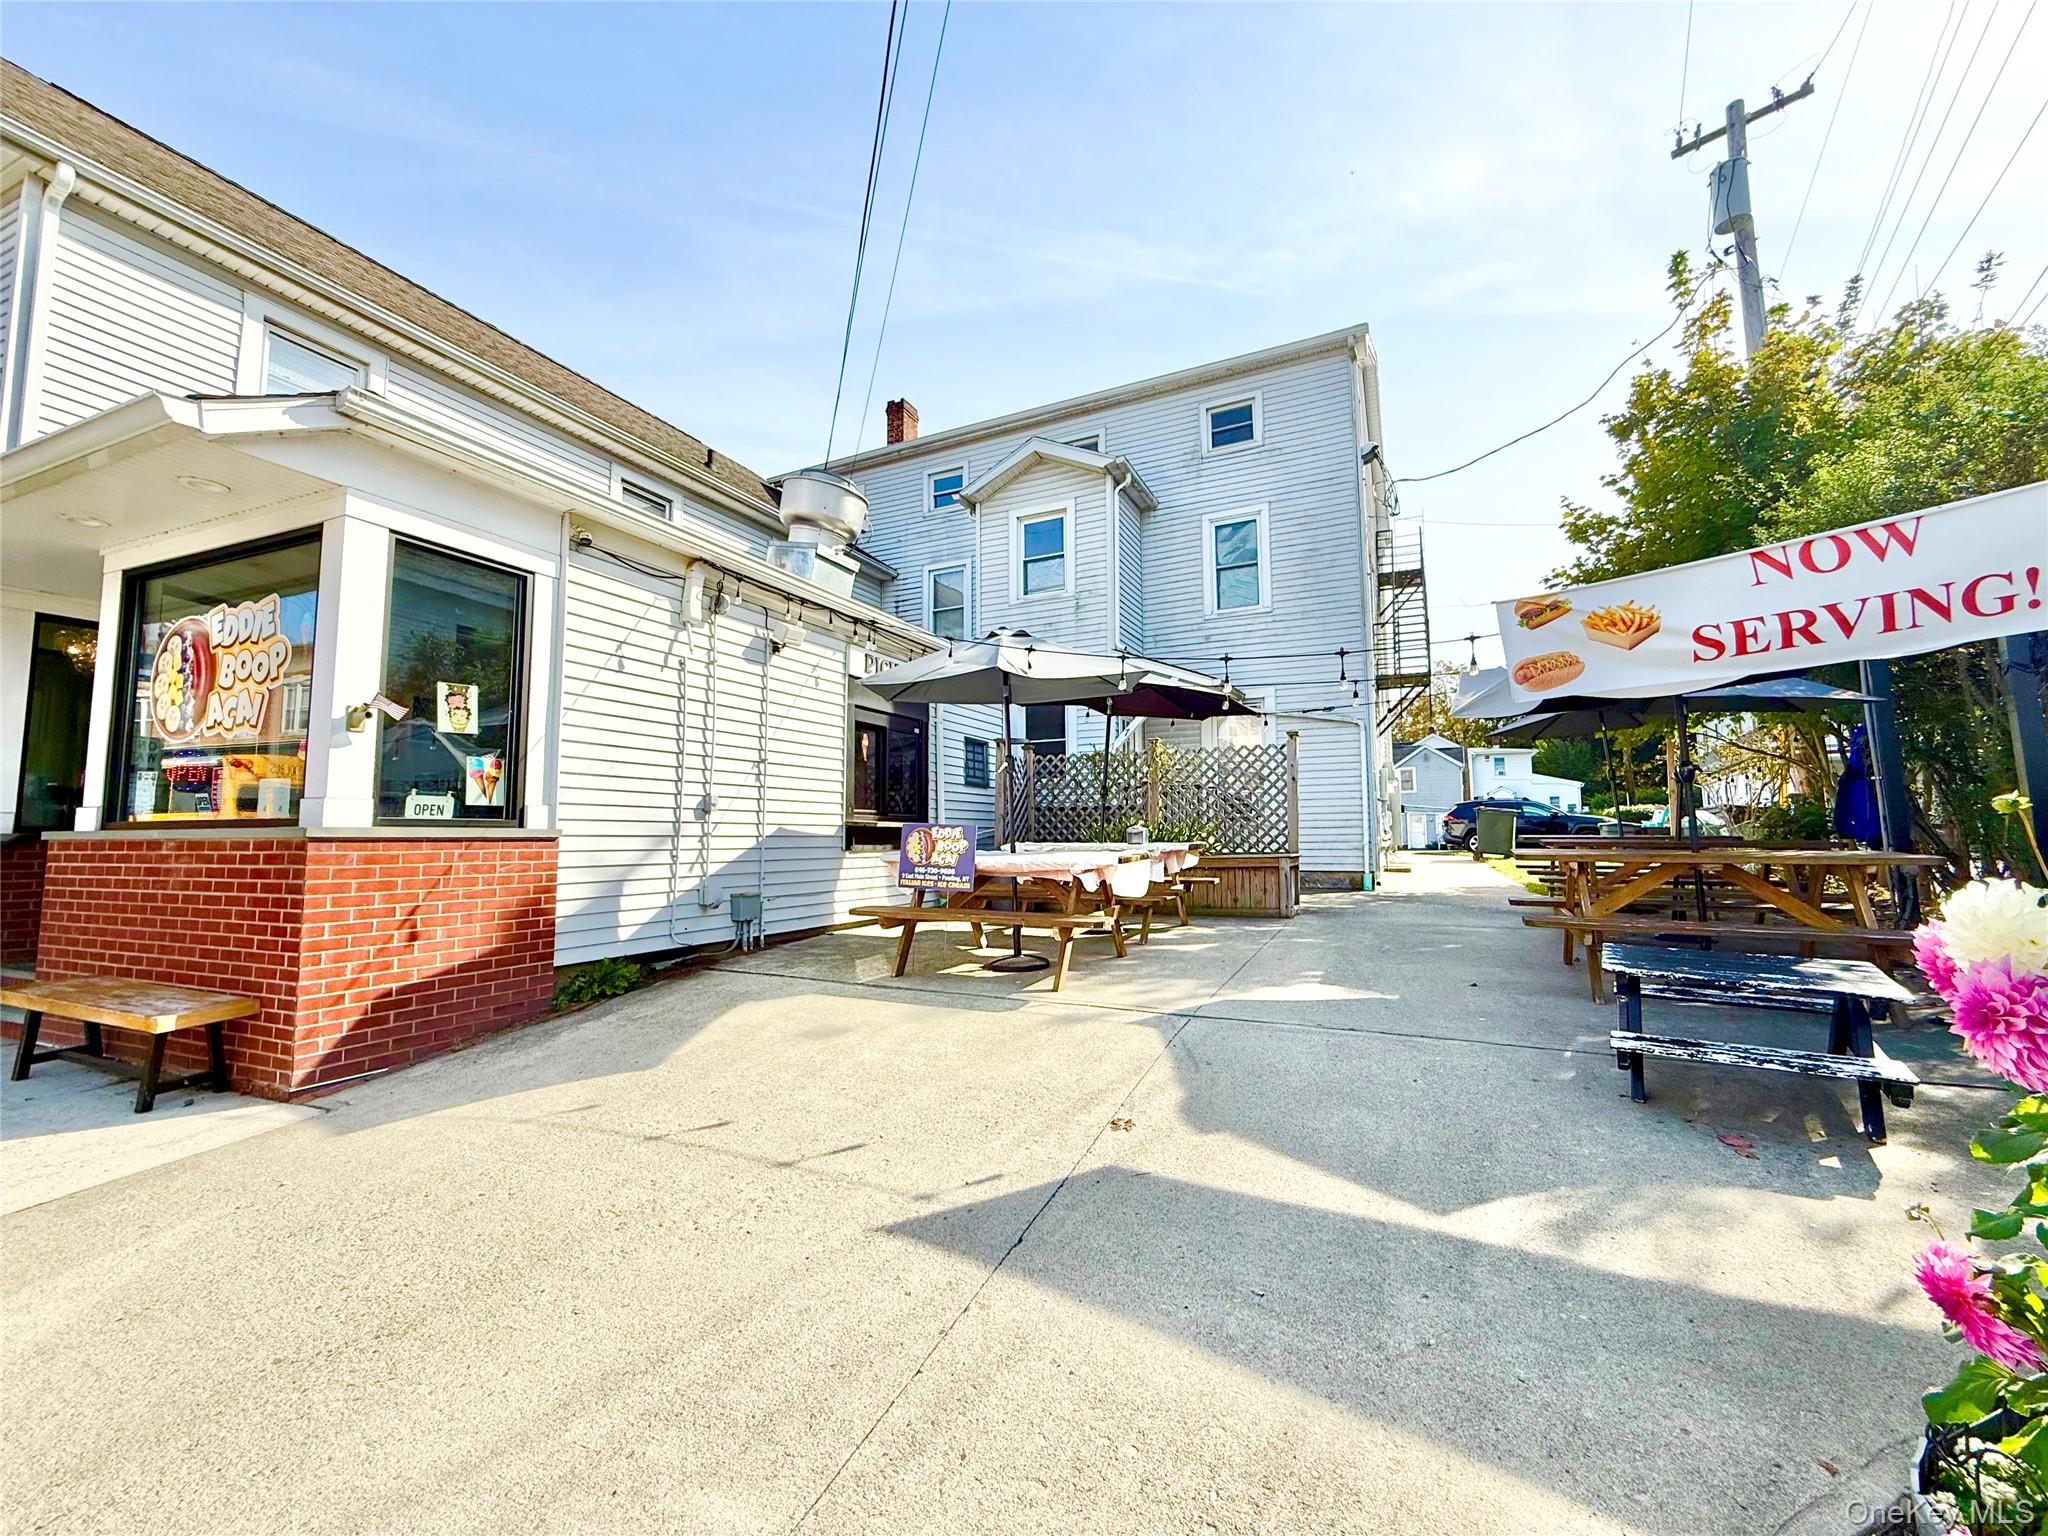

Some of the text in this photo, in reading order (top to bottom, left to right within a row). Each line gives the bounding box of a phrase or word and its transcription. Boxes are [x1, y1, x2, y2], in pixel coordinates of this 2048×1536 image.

[1750, 515, 1925, 587] NOW
[211, 600, 276, 649] EDDIE
[1691, 566, 2042, 664] SERVING!
[218, 640, 287, 690] BOOP
[206, 688, 263, 730] ACAI
[413, 803, 445, 816] OPEN
[931, 827, 963, 841] EDDIE
[937, 840, 969, 853] BOOP
[931, 853, 959, 866] ACAI
